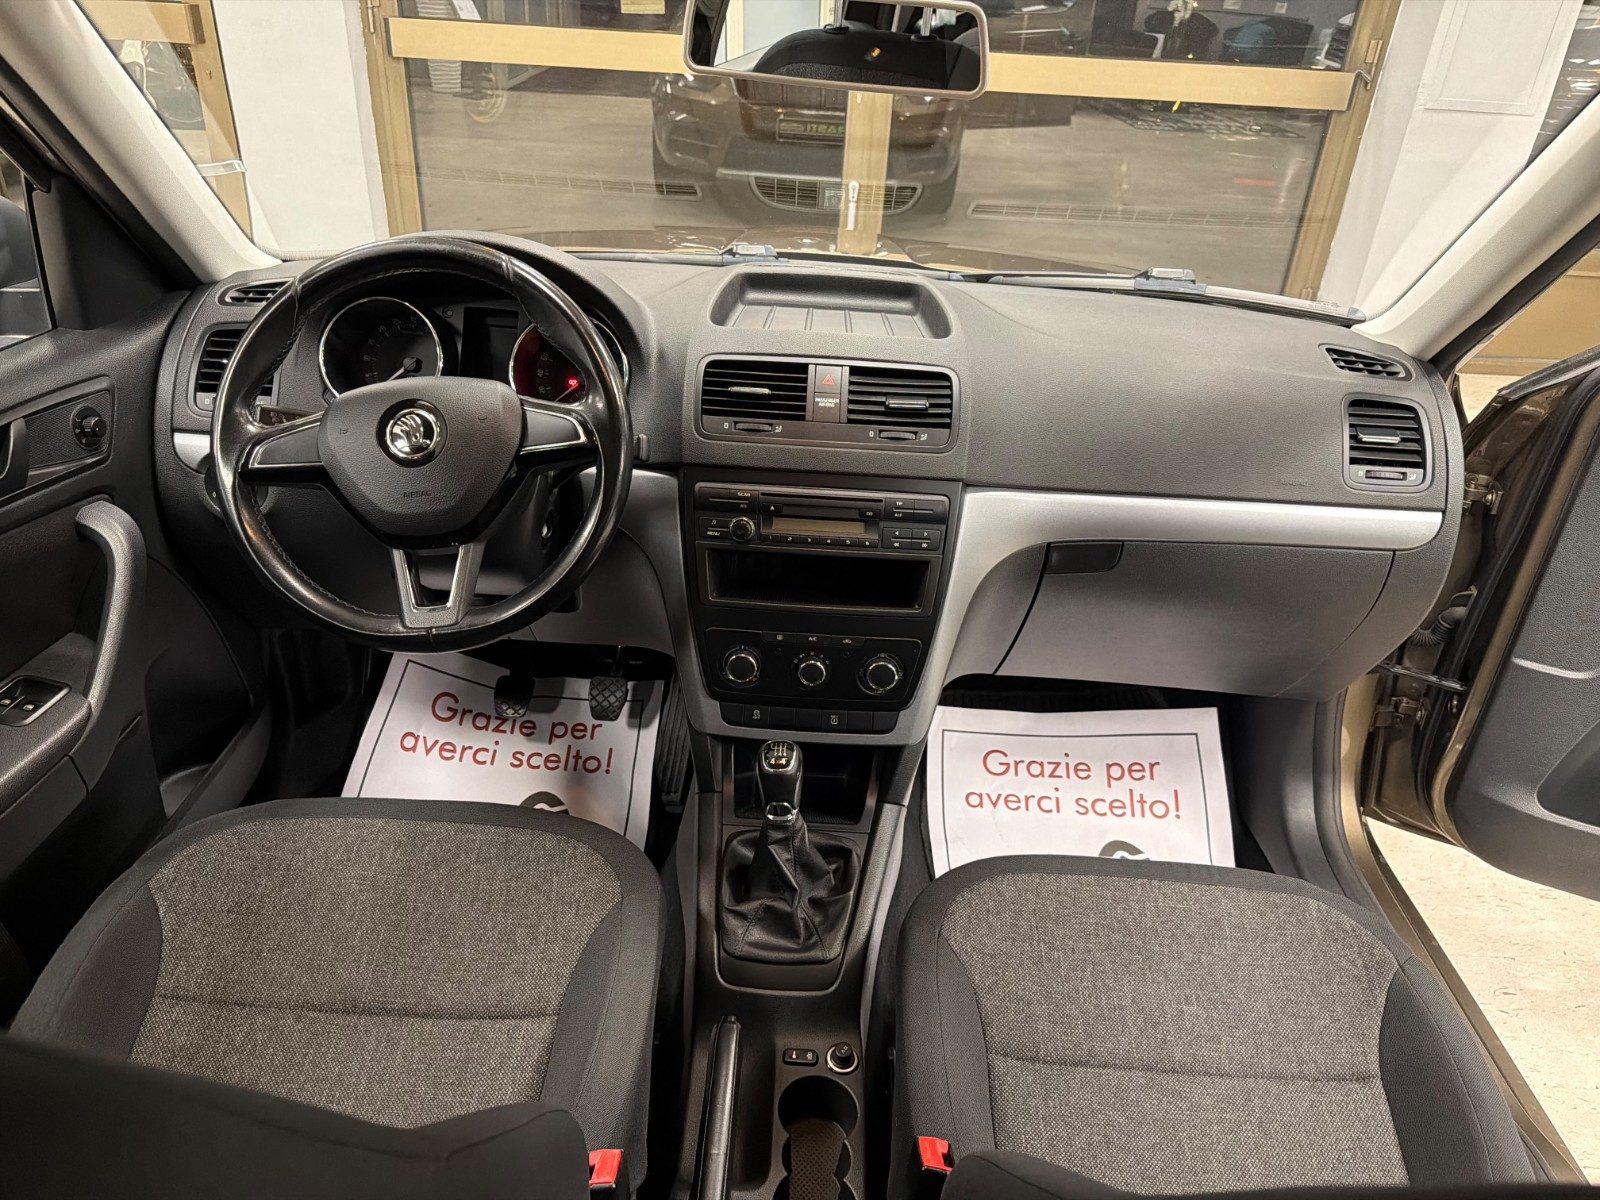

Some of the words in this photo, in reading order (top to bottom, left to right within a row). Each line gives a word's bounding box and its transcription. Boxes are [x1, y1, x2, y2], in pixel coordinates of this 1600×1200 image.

[431, 691, 538, 736] Grazie
[549, 720, 603, 744] per
[399, 730, 501, 767] averci
[509, 744, 614, 775] scelto!
[982, 749, 1092, 780] Grazie
[1105, 760, 1160, 788] per
[964, 786, 1061, 814] averci
[1075, 788, 1181, 820] scelto!
